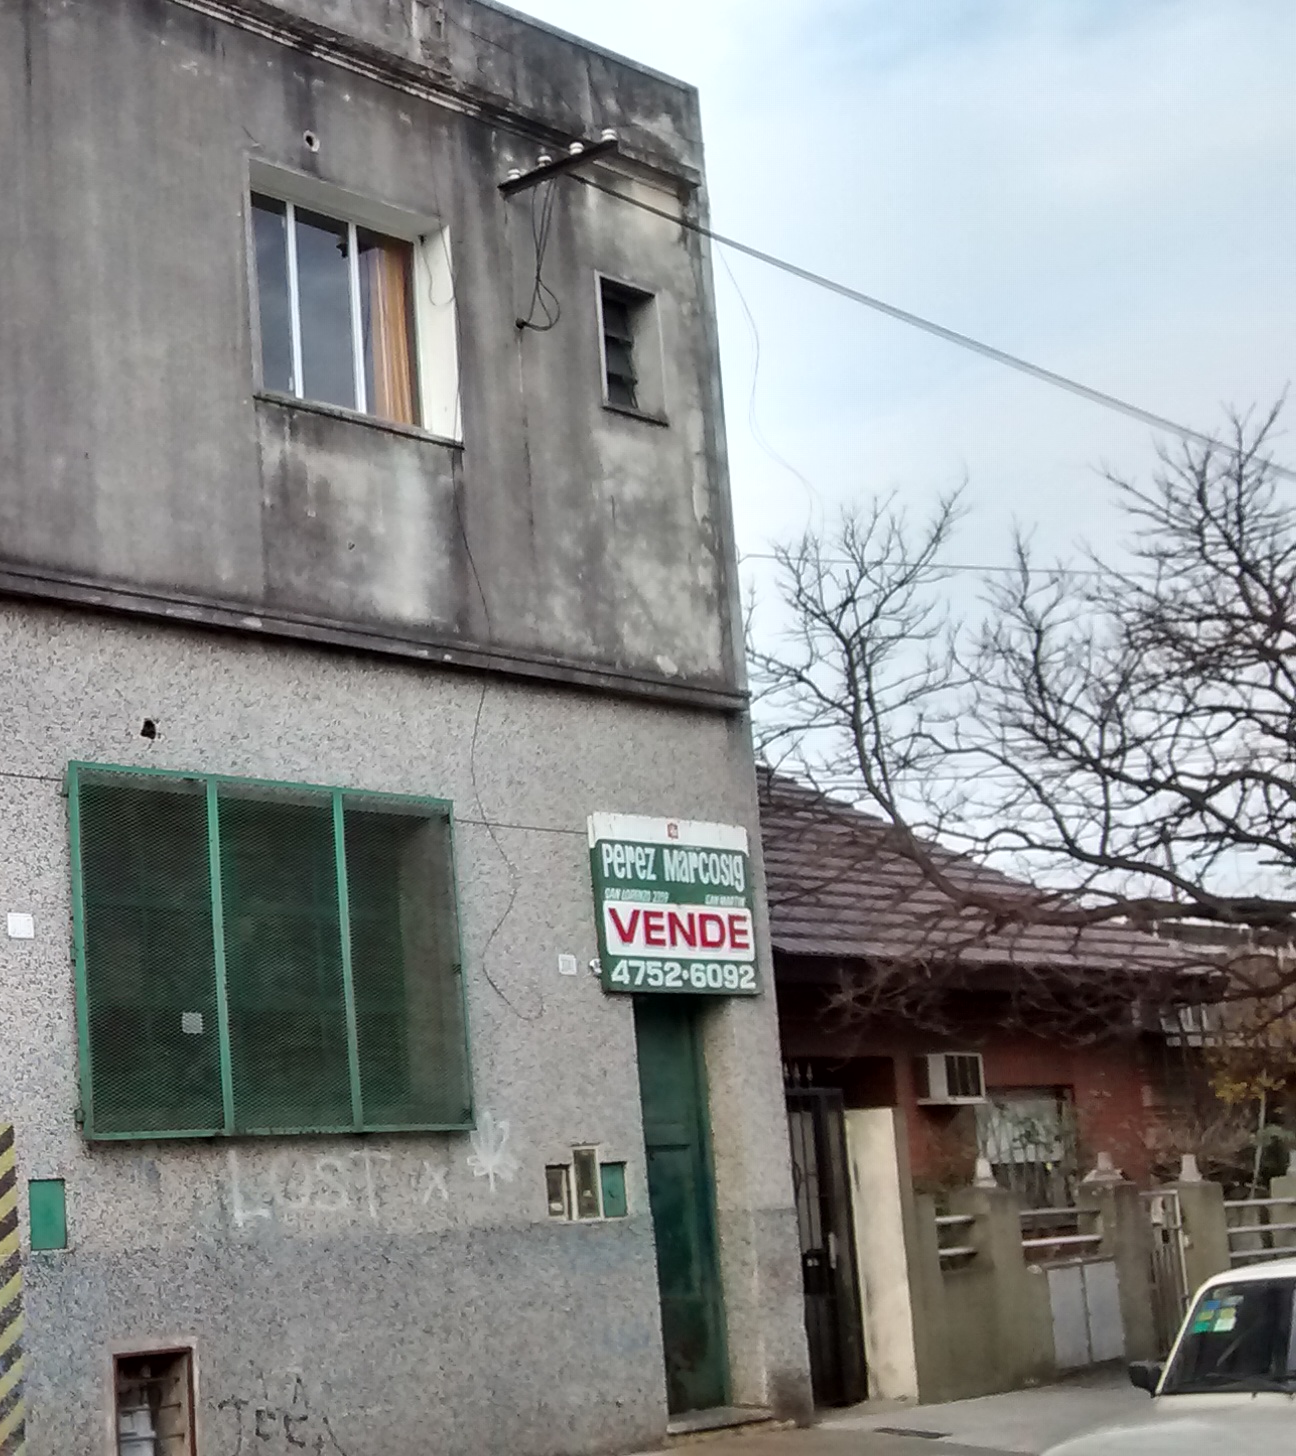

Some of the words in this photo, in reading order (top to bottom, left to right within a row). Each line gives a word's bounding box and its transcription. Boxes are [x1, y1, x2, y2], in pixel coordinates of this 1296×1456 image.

[601, 843, 657, 881] Perez
[663, 848, 746, 892] Marcosig
[608, 907, 750, 950] VENDE
